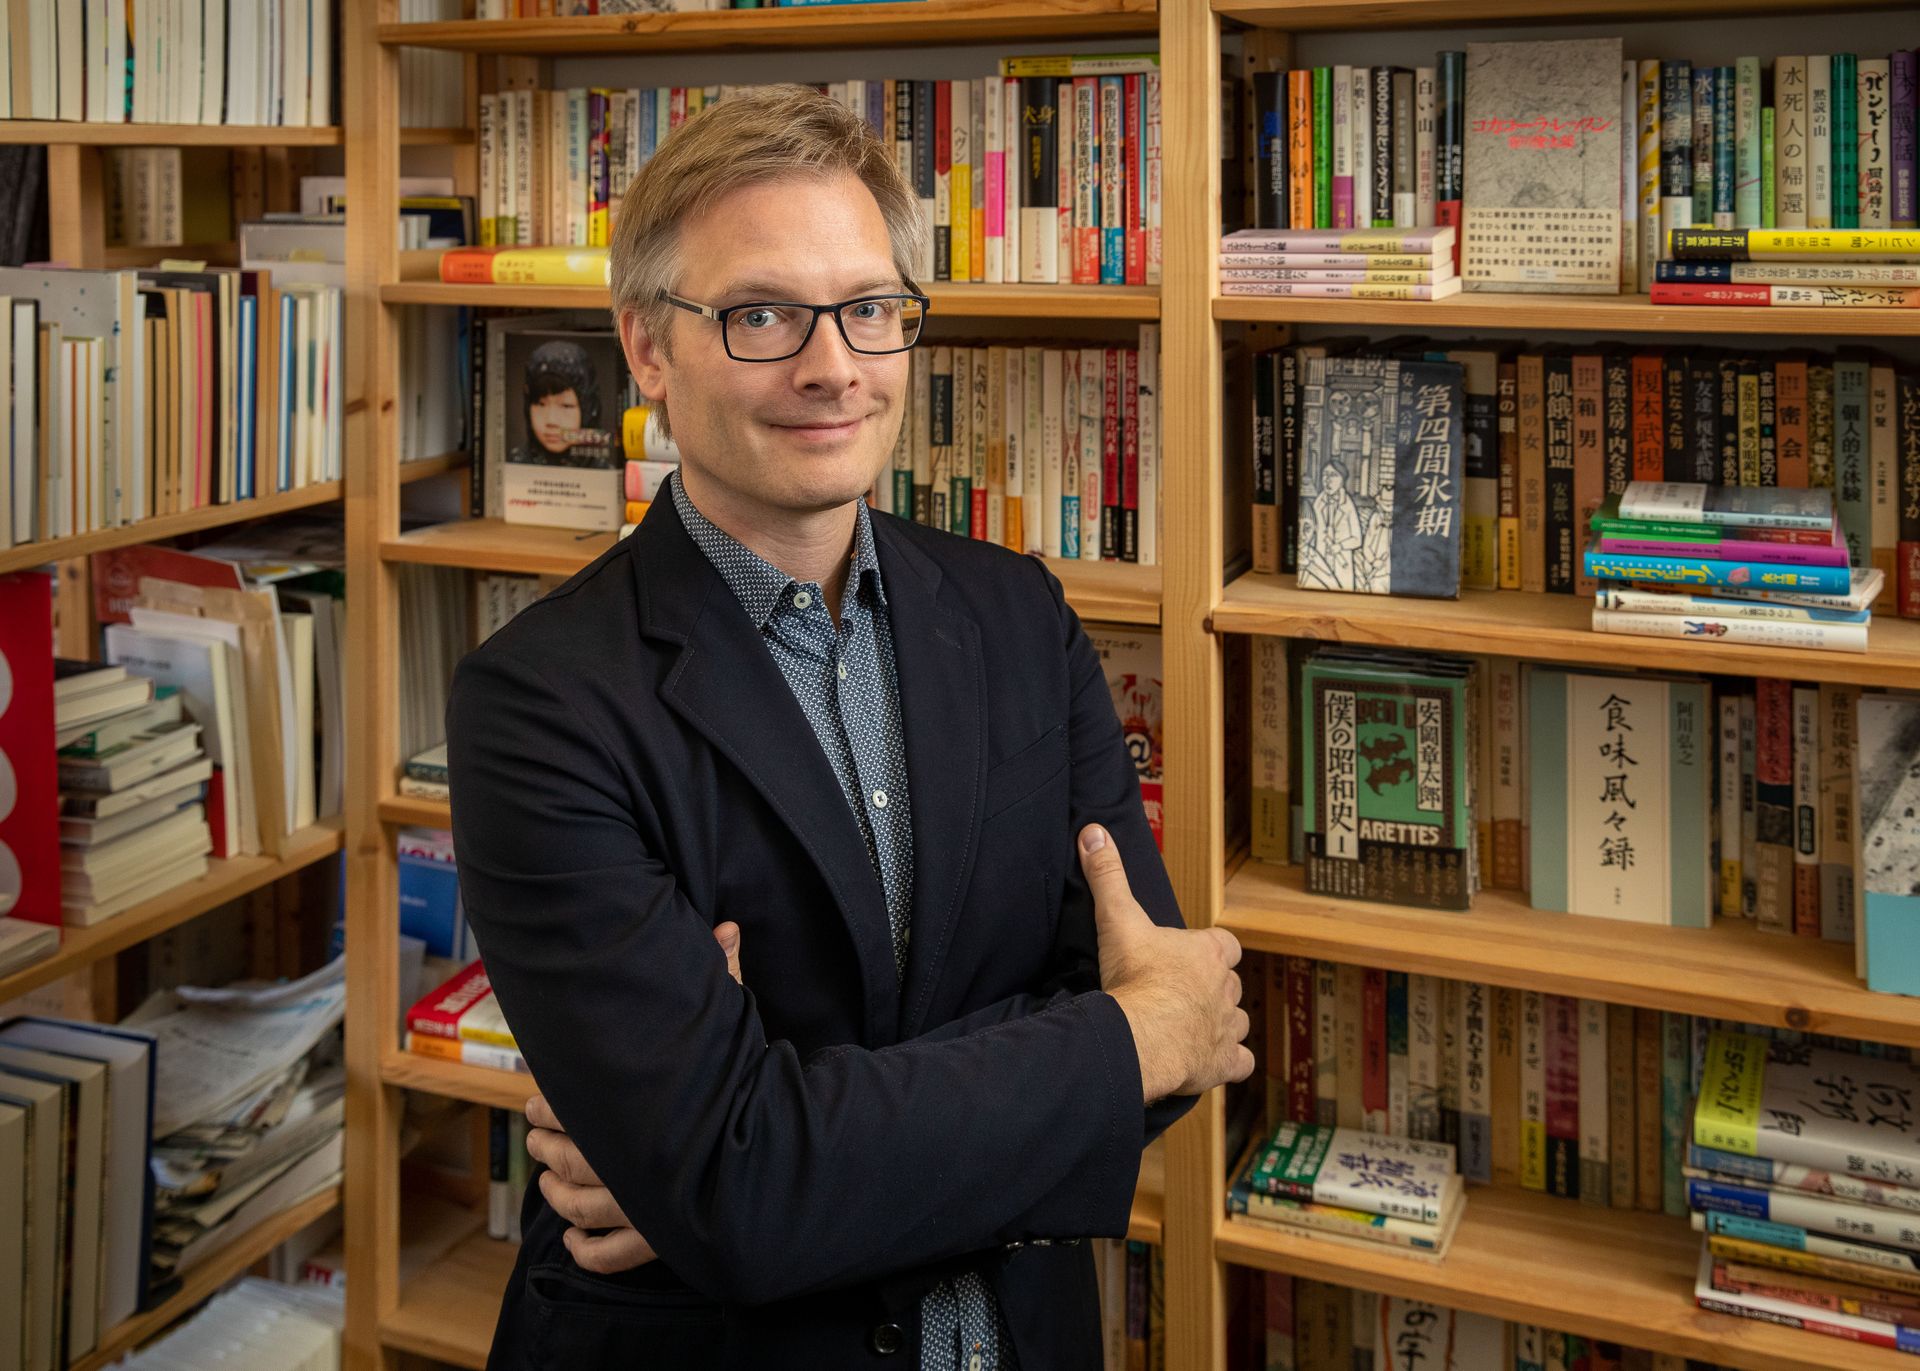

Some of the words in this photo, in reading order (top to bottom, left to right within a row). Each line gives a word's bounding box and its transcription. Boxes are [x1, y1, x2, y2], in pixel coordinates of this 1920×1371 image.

[1022, 104, 1056, 125] 犬身
[1418, 79, 1434, 133] 白い山
[1813, 89, 1827, 138] 黙読の山
[953, 126, 968, 164] ヘヴン
[1376, 69, 1391, 219] 1000の小説とバックベアード
[1782, 65, 1804, 215] 水死人の帰還
[1897, 168, 1911, 219] 伊藤比呂美
[1685, 235, 1748, 249] 芥川賞受賞
[1771, 237, 1832, 248] 村田沙耶香
[1818, 286, 1908, 306] はぐれ雀
[974, 362, 987, 424] 犬婿入り
[1281, 356, 1297, 406] 安部公房
[1398, 370, 1416, 446] 安部公房
[1498, 378, 1516, 434] 石の眼
[1760, 370, 1775, 425] 安部公房
[1522, 392, 1539, 452] 砂の女
[1577, 395, 1598, 450] 箱男
[1668, 370, 1685, 451] 棒になった男
[1779, 404, 1802, 461] 密会
[1413, 383, 1454, 539] 第四間氷期
[1840, 403, 1862, 504] 個人的な体験
[1903, 385, 1920, 520] いかに木を殺すか
[1876, 460, 1887, 505] 大江健三郎
[1418, 700, 1441, 810] 安岡章太郎
[1676, 701, 1695, 767] 阿川弘之
[1724, 703, 1737, 765] 再婚者
[1831, 691, 1851, 769] 落花流水
[1327, 690, 1355, 833] 僕の昭和史
[1599, 692, 1639, 872] 食味風々録
[1359, 819, 1441, 846] ARETTES
